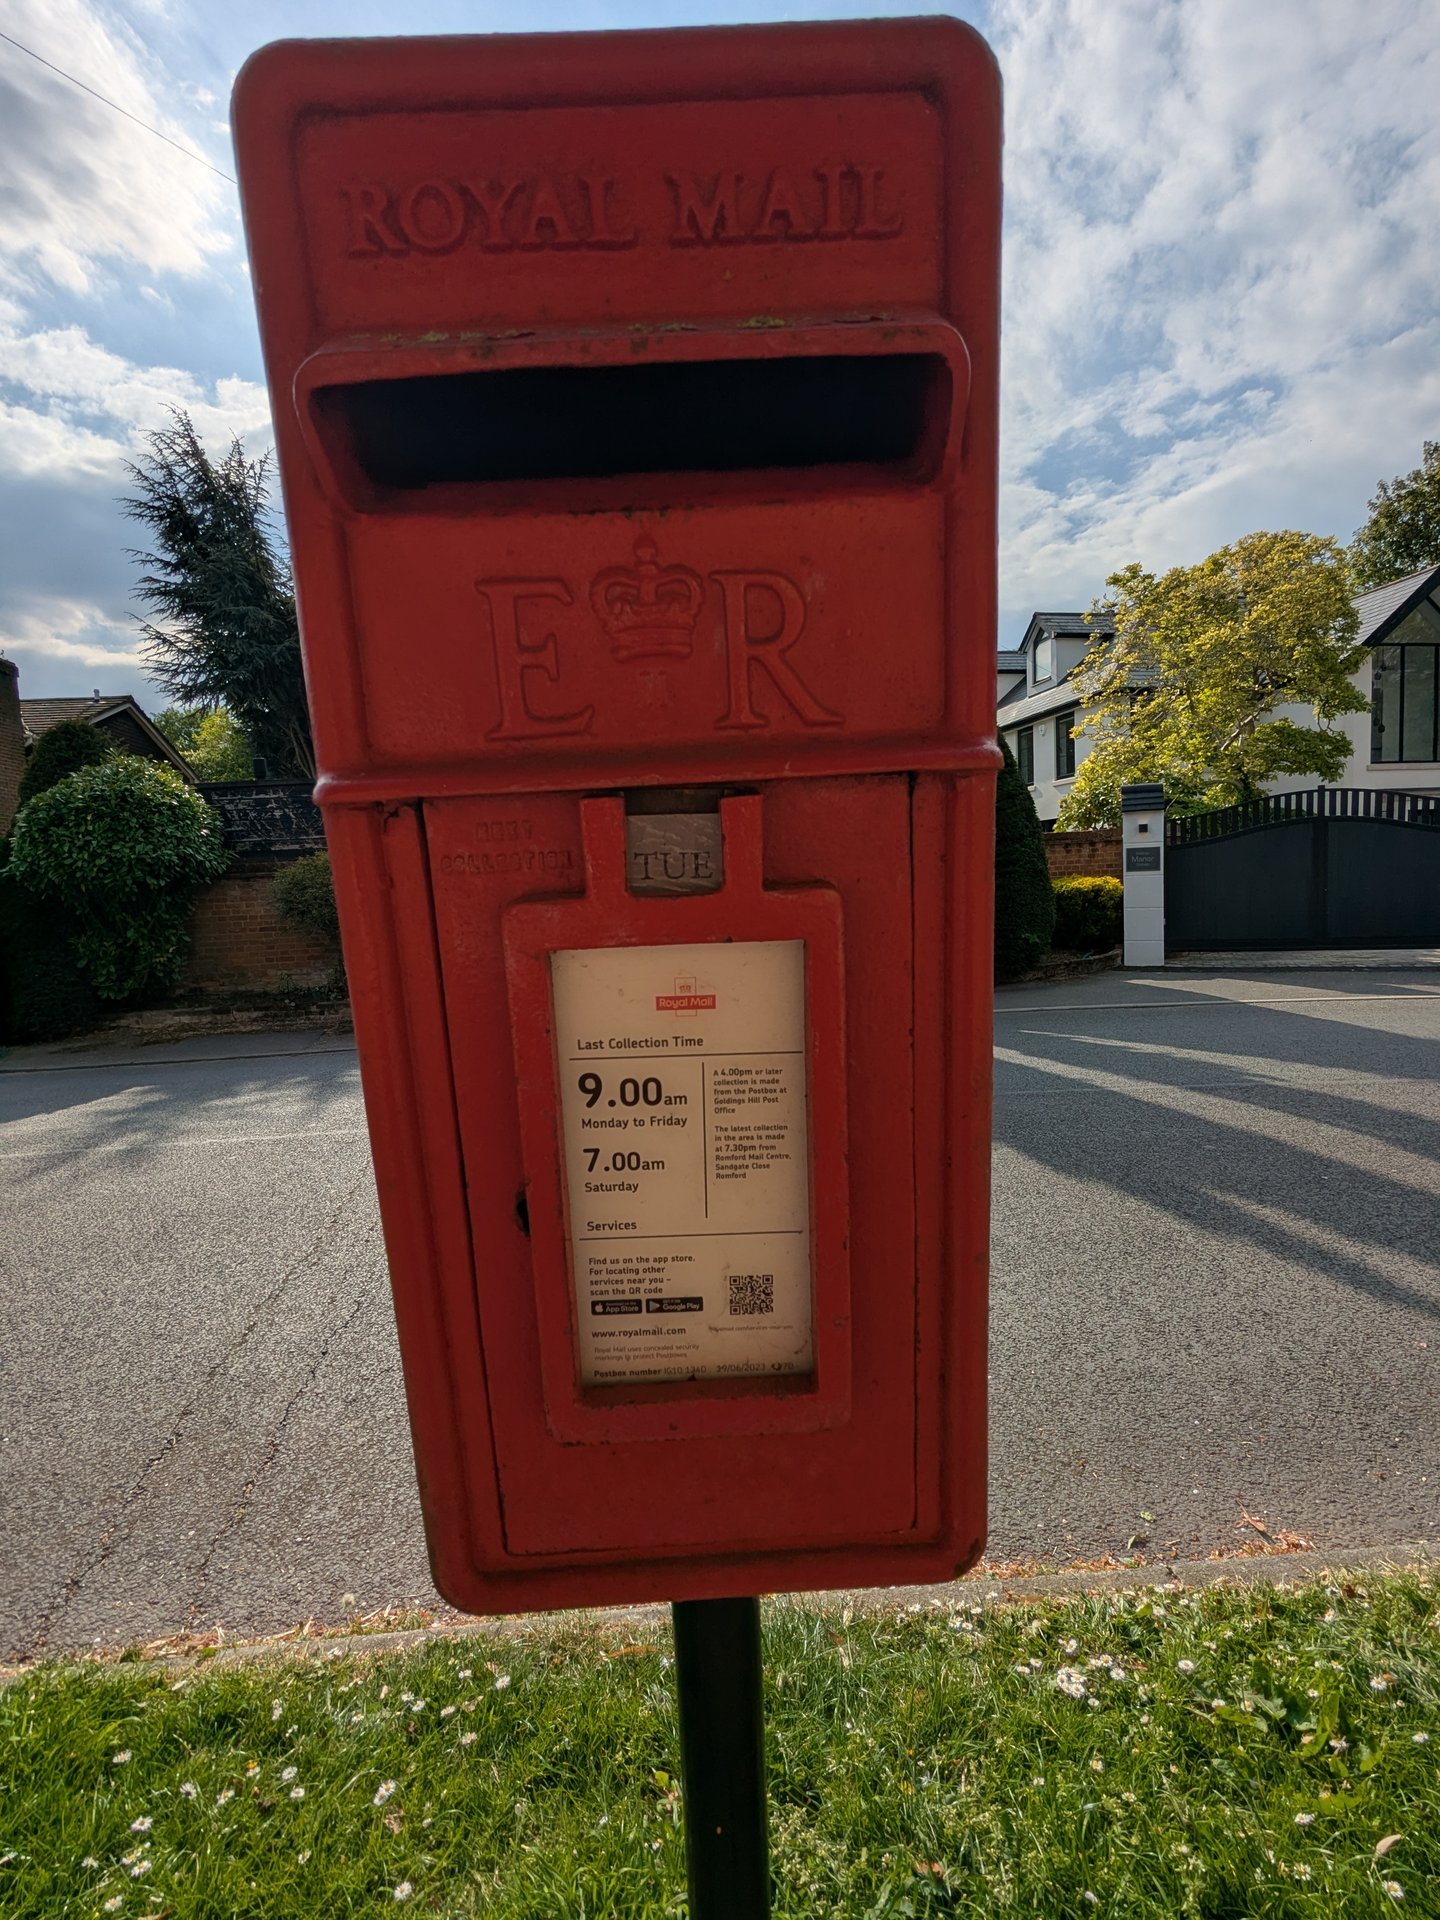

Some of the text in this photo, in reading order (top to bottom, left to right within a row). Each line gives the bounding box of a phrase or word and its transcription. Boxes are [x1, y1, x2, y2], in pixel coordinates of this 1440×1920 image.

[341, 161, 904, 259] ROYAL MAIL
[474, 569, 846, 742] E R
[634, 851, 713, 880] TUE
[660, 997, 713, 1008] Royal Mail
[577, 1036, 704, 1050] Last Collection Time
[721, 1068, 752, 1077] 4.00pm
[578, 1072, 687, 1108] 9.00am
[714, 1097, 745, 1105] Goldings
[582, 1115, 687, 1130] Monday to Friday
[724, 1144, 756, 1152] 7.30pm
[583, 1148, 665, 1172] 7.00am
[585, 1181, 639, 1193] Saturday
[587, 1220, 637, 1231] Services
[589, 1257, 607, 1265] Find
[606, 1267, 639, 1275] locating
[642, 1266, 665, 1274] other
[589, 1278, 624, 1286] services
[649, 1277, 664, 1285] you
[612, 1287, 626, 1295] the
[591, 1327, 686, 1338] www.royalmail.com
[643, 1343, 673, 1352] concealed
[675, 1343, 699, 1351] security
[633, 1353, 654, 1361] protect
[594, 1369, 626, 1377] Postbox
[629, 1368, 661, 1376] number
